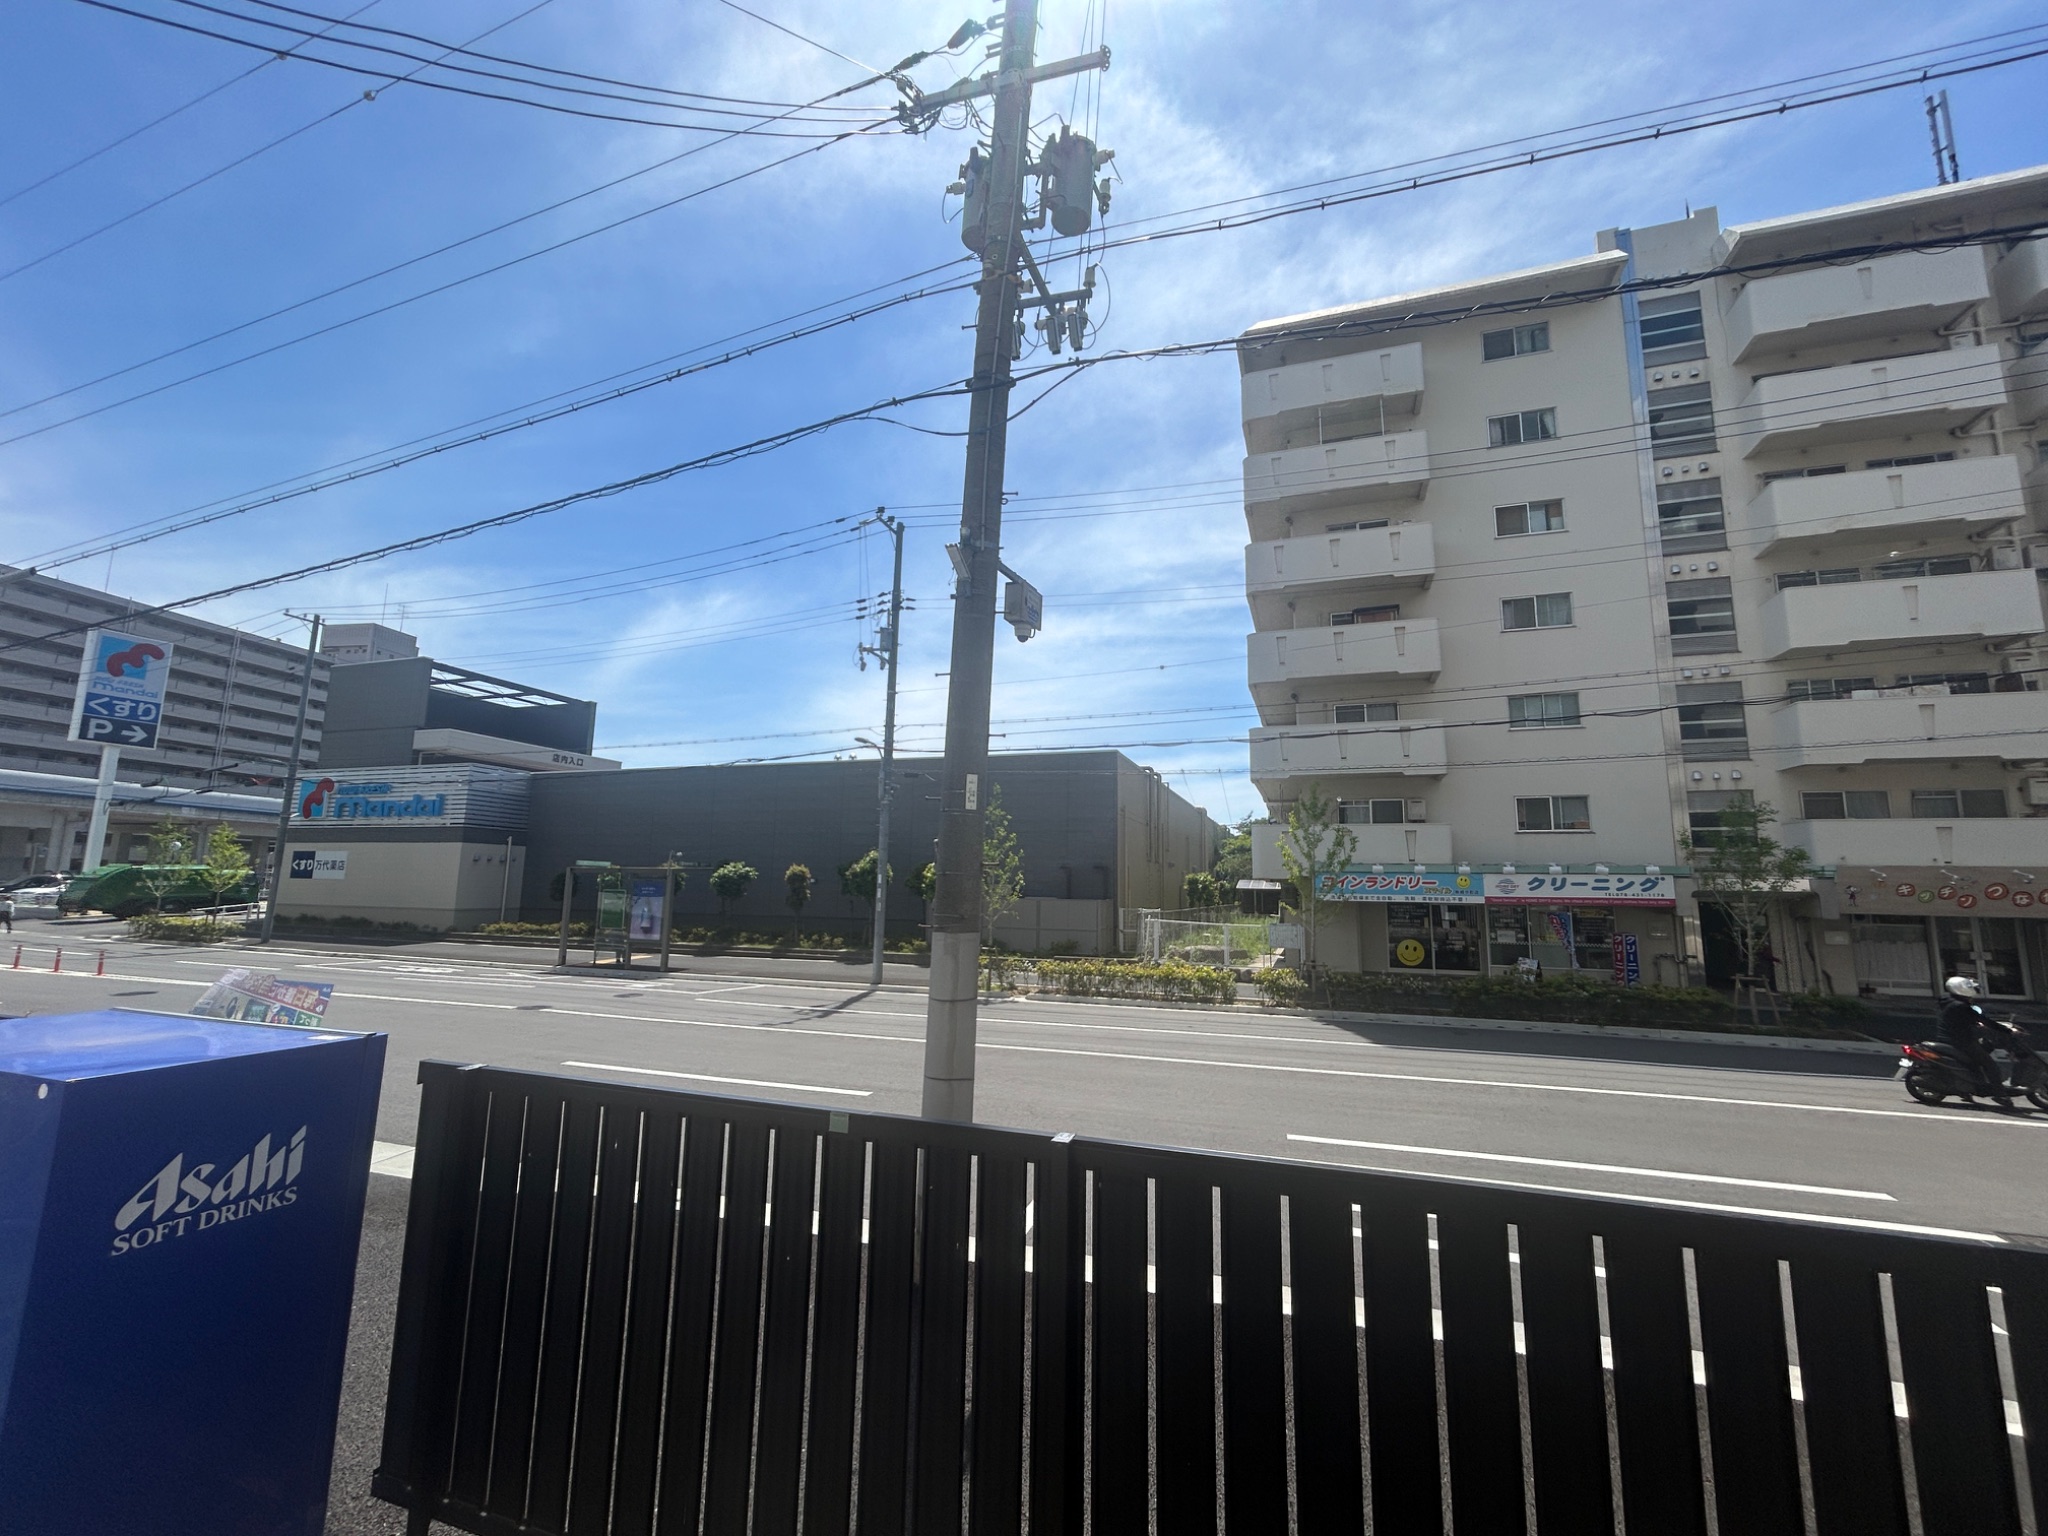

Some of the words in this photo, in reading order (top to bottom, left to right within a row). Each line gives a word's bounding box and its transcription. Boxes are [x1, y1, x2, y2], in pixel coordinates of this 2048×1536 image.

[92, 680, 159, 699] mandai
[88, 696, 157, 720] くすり
[86, 718, 113, 739] P
[552, 753, 584, 766] 店内入口
[334, 793, 446, 818] mandai
[292, 859, 314, 870] くすり
[315, 859, 345, 871] 万代薬店
[1321, 875, 1438, 890] コインランドリー
[1527, 876, 1666, 892] クリーニング
[1897, 884, 1976, 908] キッチン
[114, 1125, 307, 1231] Asahi
[110, 1216, 192, 1256] SOFT
[197, 1186, 298, 1230] DRINKS
